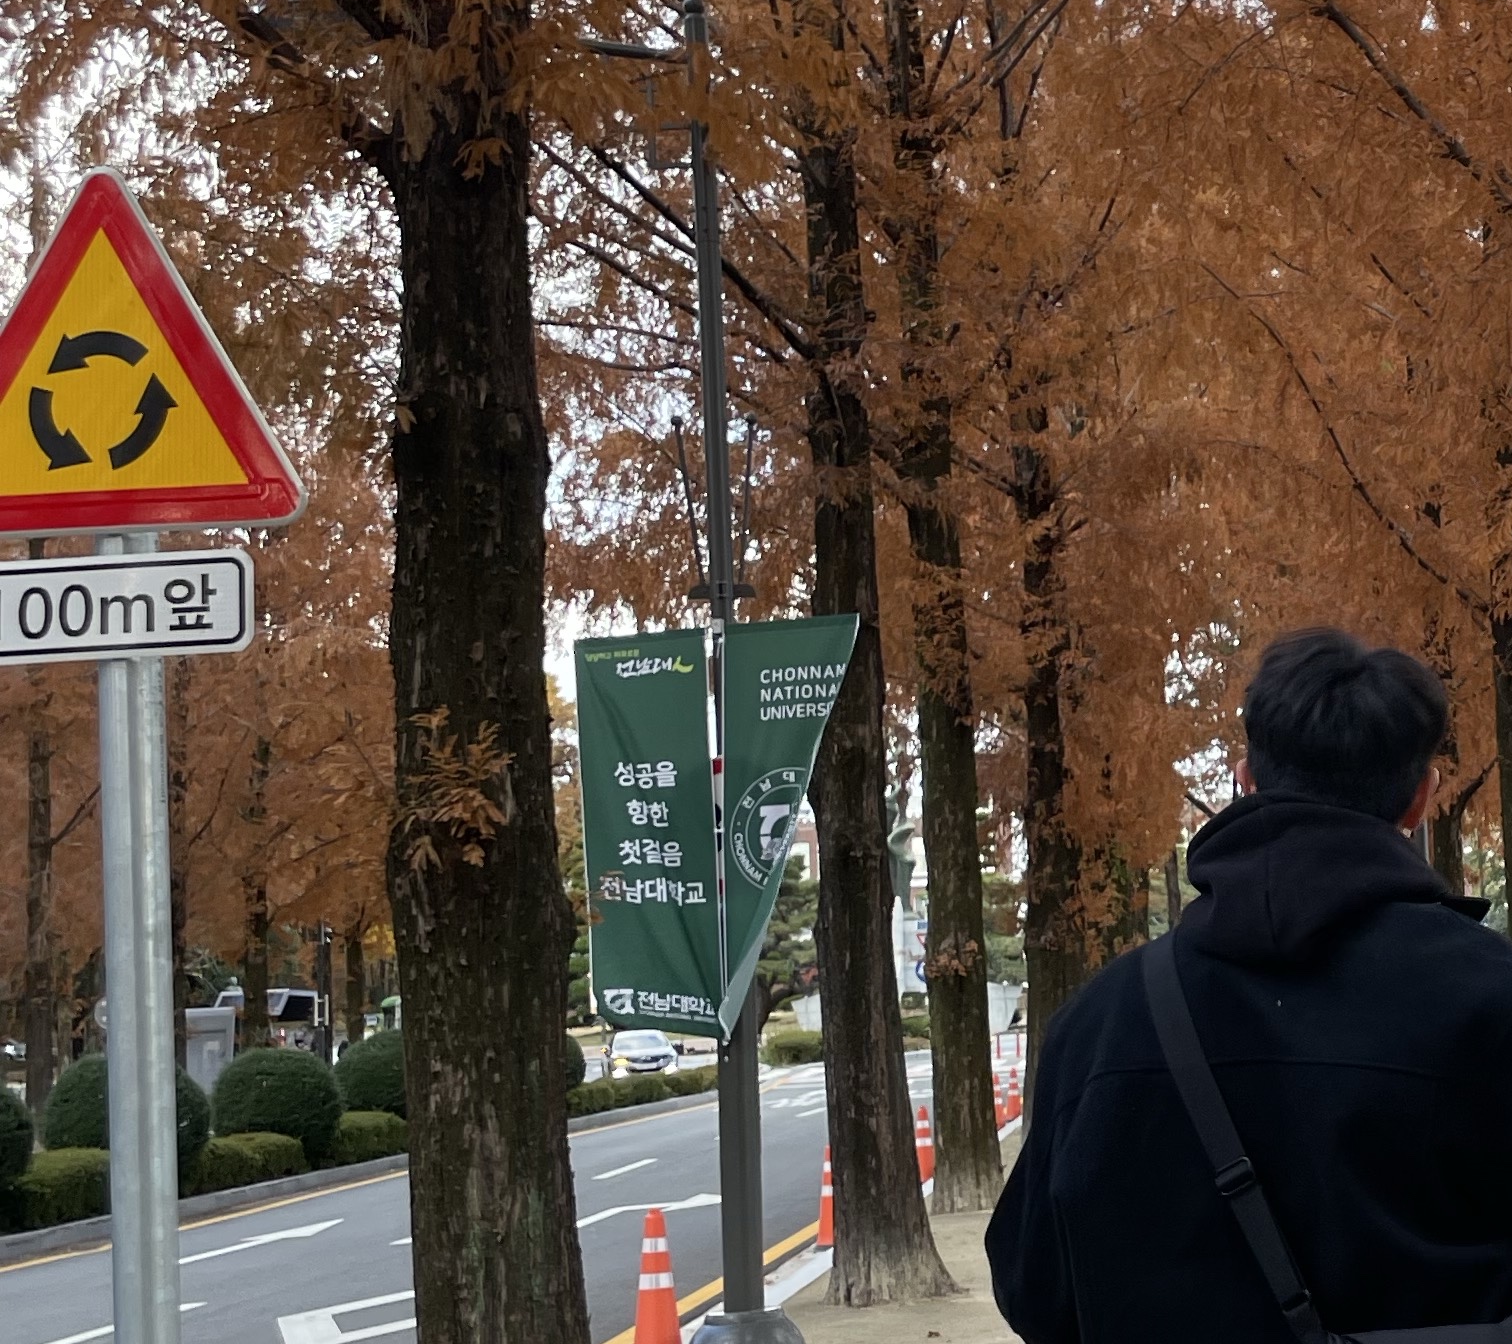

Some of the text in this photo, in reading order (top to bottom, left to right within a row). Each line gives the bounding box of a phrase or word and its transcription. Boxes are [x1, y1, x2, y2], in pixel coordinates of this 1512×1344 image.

[0, 573, 217, 640] 00m앞
[760, 663, 846, 684] CHONNAM
[760, 682, 841, 702] NATIONA
[614, 760, 678, 789] 성공을
[625, 798, 669, 827] 향한
[618, 838, 683, 868] 첫걸음
[600, 875, 707, 906] 전남대학교
